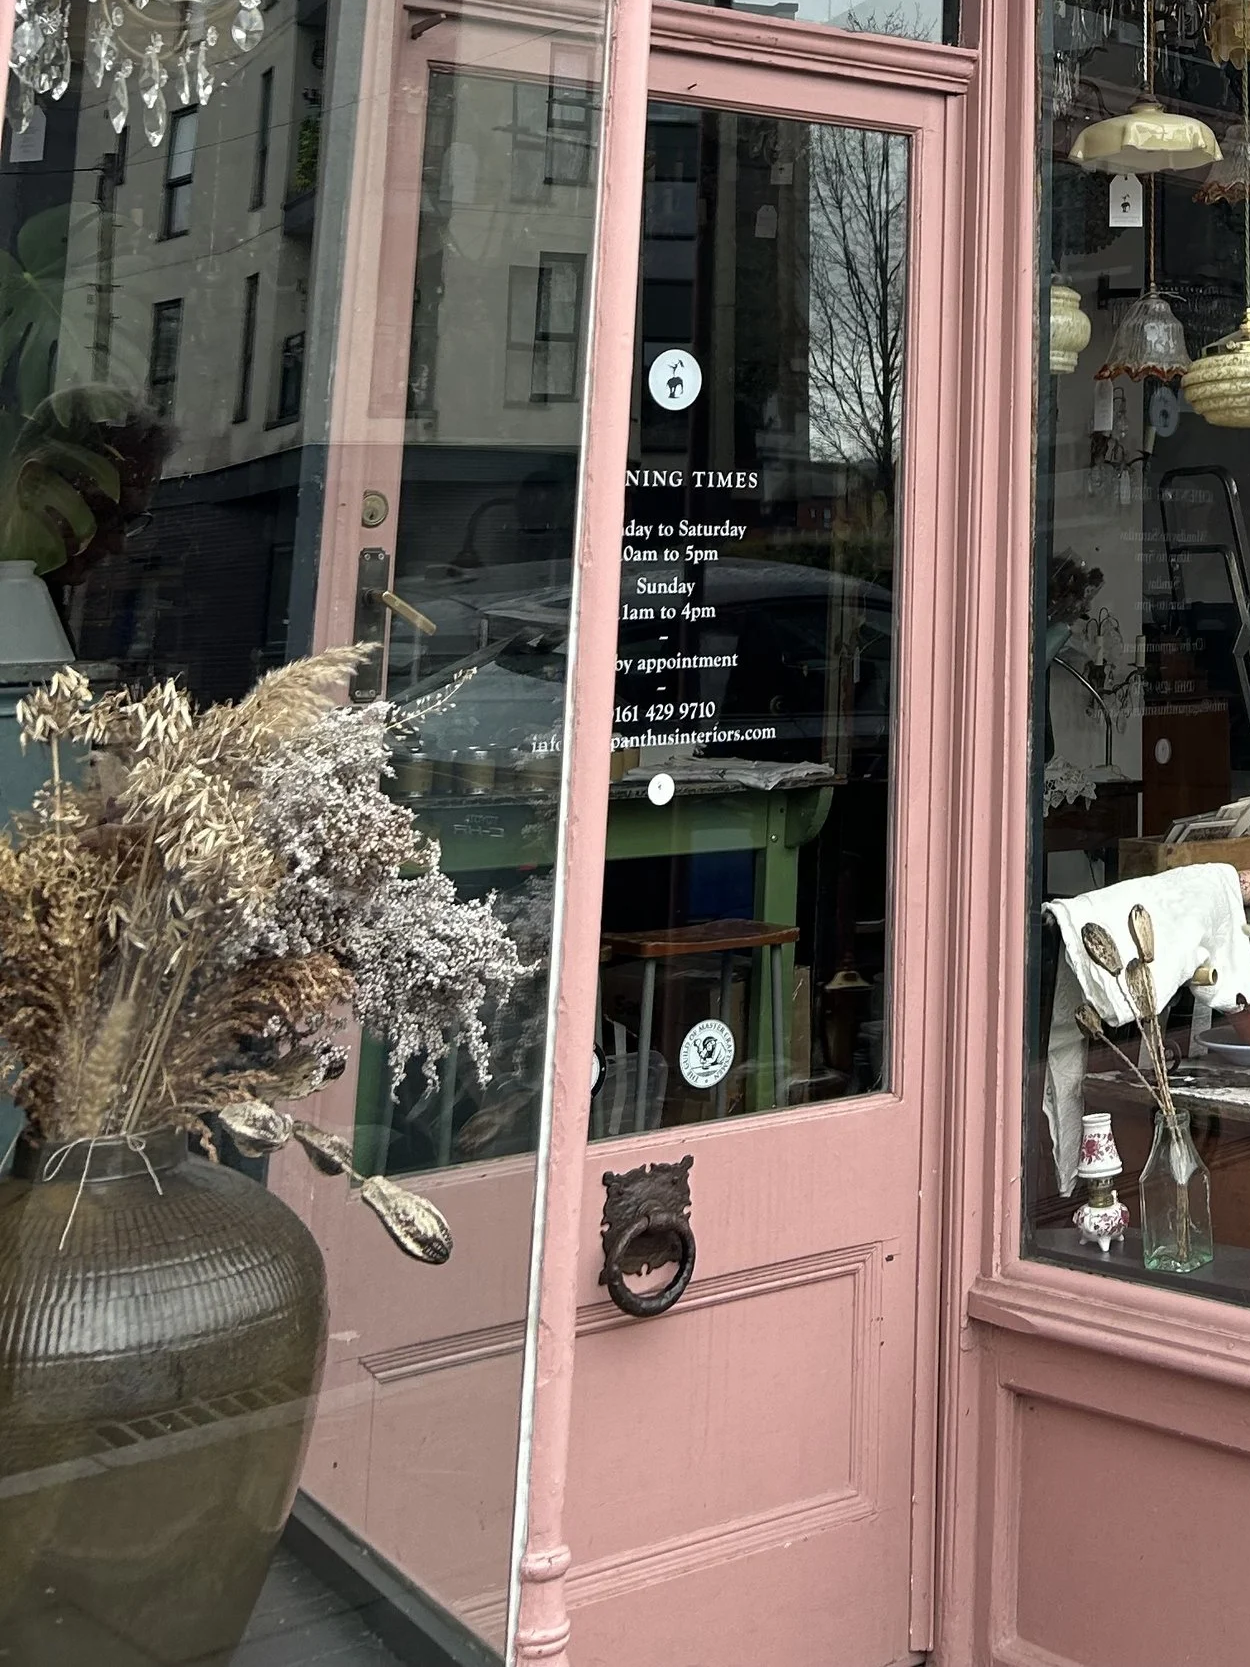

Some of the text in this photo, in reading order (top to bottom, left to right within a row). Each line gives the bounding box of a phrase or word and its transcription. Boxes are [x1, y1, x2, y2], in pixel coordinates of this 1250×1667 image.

[625, 470, 758, 489] NING TIMES
[623, 519, 747, 540] day to Saturday
[621, 544, 719, 564] 0am to 5pm
[636, 577, 696, 597] Sunday
[620, 603, 717, 622] 1am to 4pm
[637, 652, 739, 674] appointment
[614, 701, 716, 724] 161 429 9710
